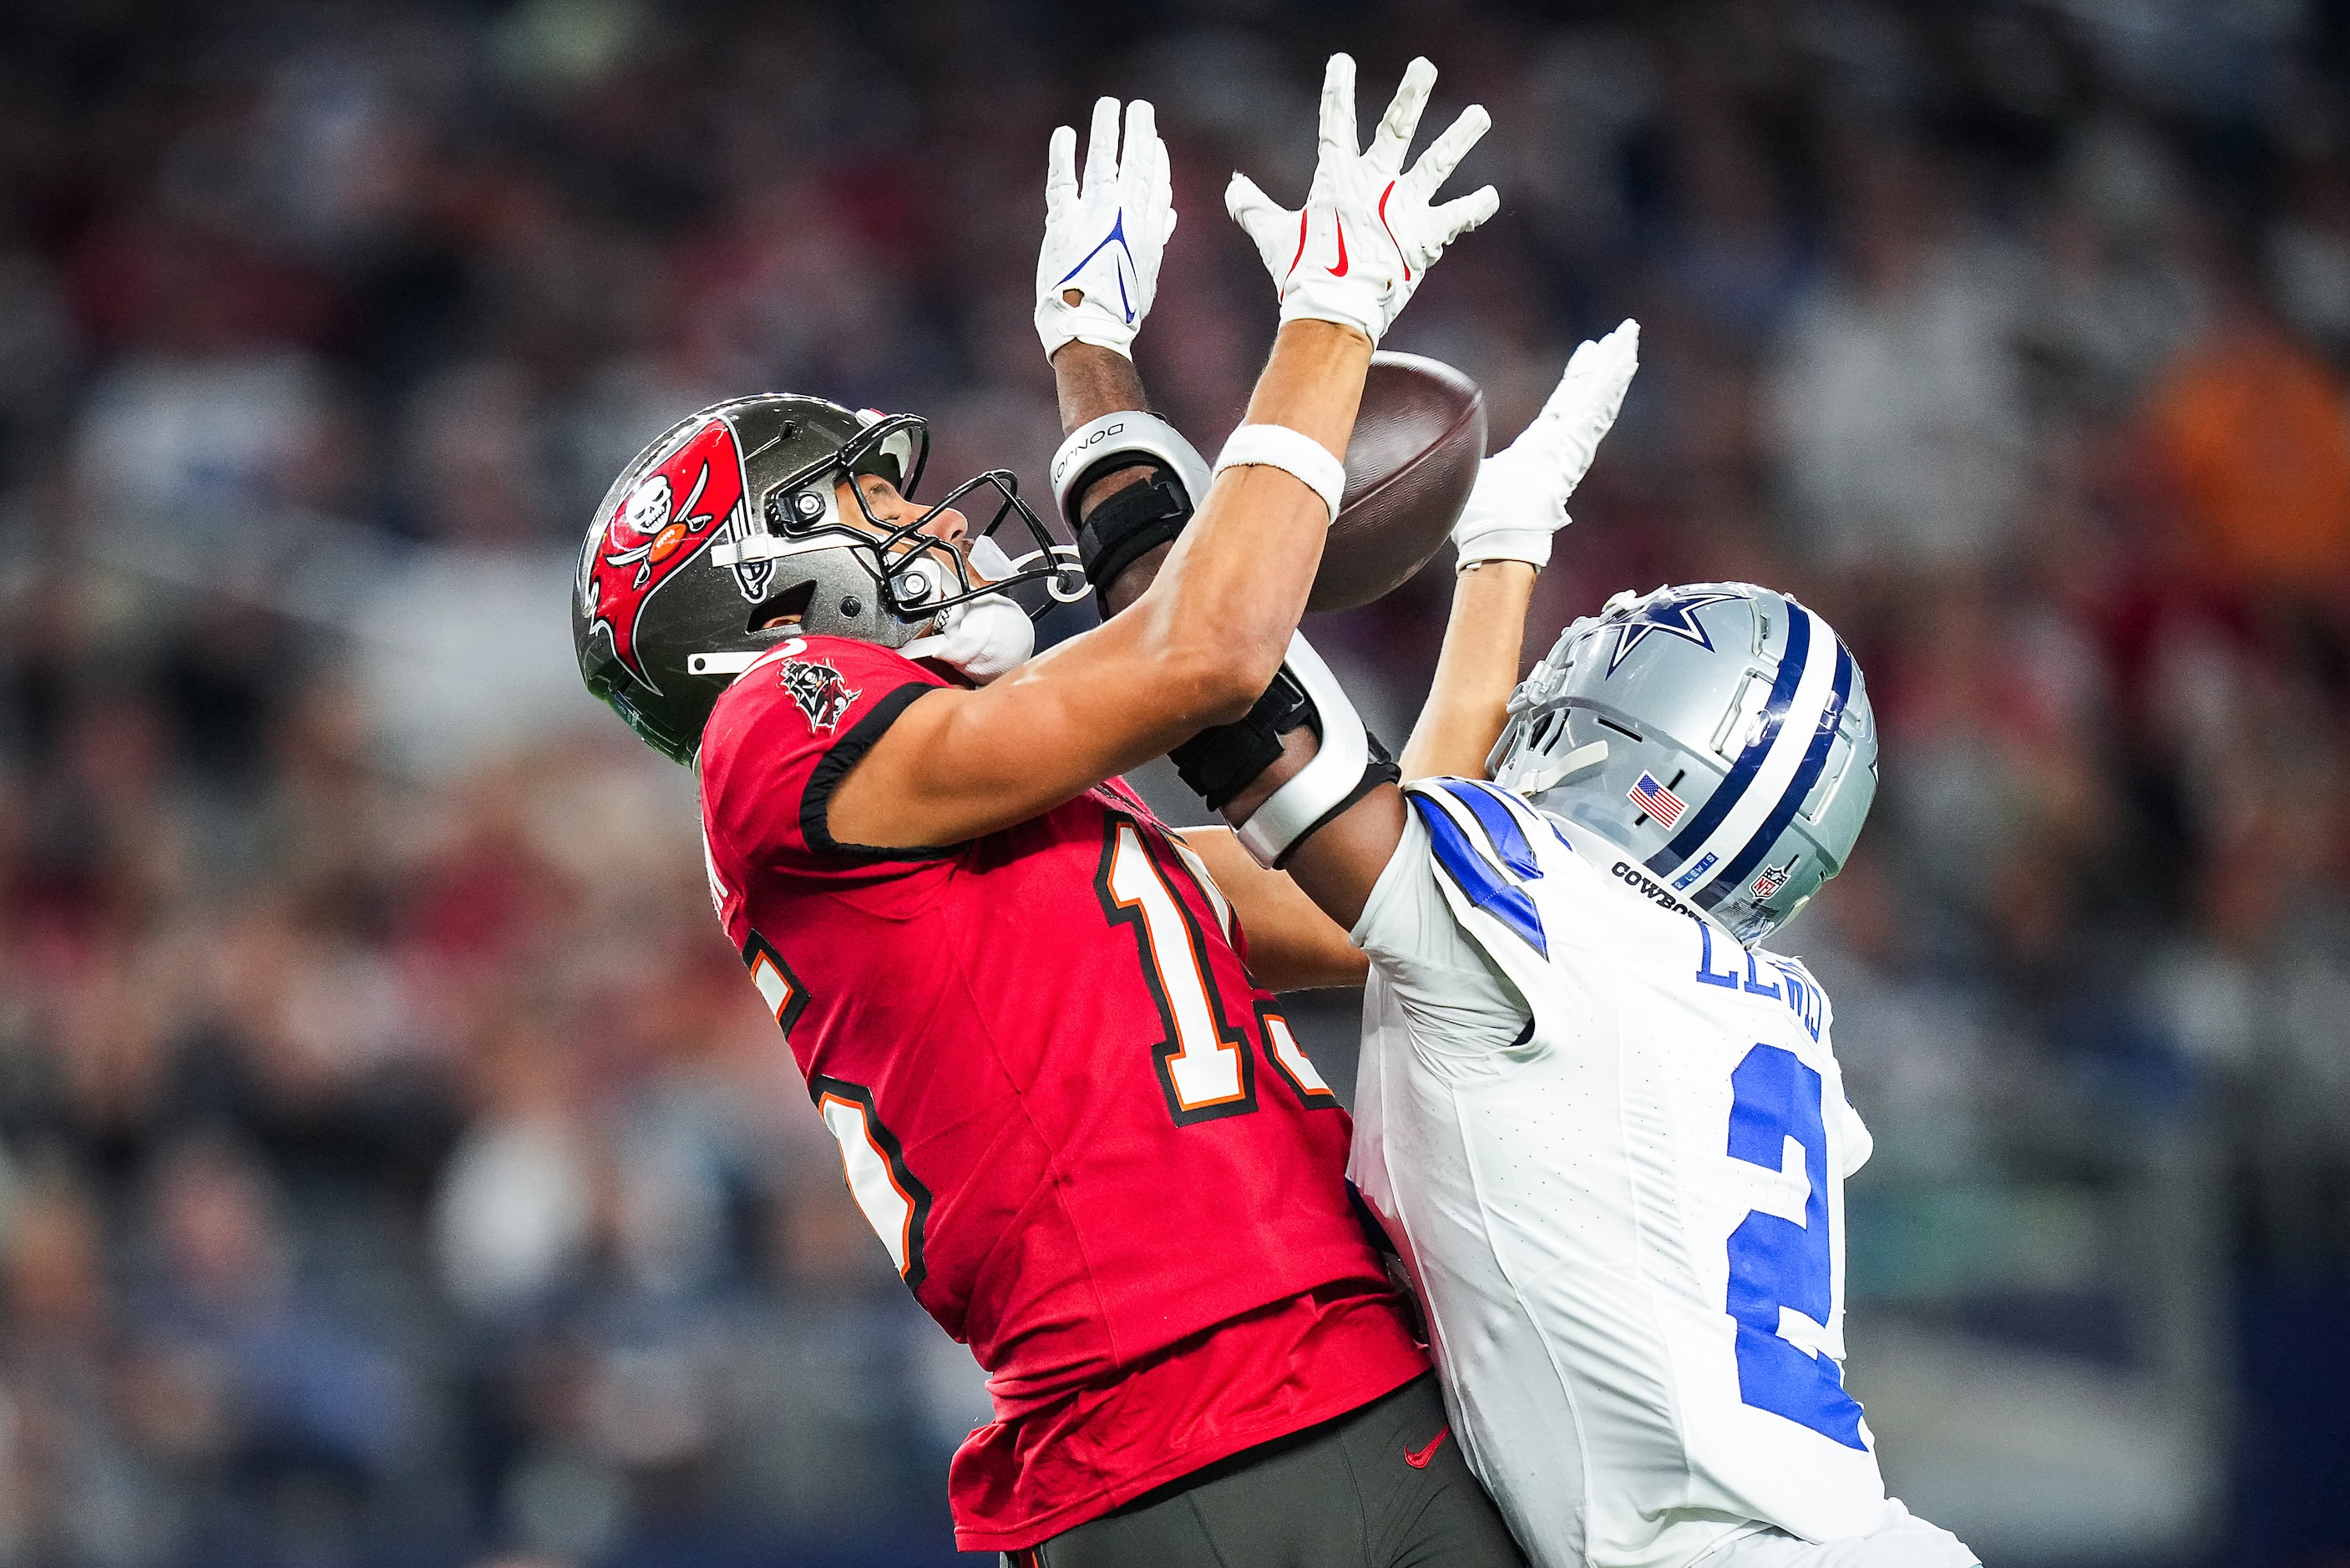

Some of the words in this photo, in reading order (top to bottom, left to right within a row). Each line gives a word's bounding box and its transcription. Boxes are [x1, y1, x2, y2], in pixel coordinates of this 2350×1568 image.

[1053, 422, 1124, 489] DONJOY
[1611, 861, 1711, 927] COWBO
[1684, 854, 1716, 883] LEWIS
[1753, 877, 1776, 896] NFL
[1726, 1042, 1869, 1452] 2
